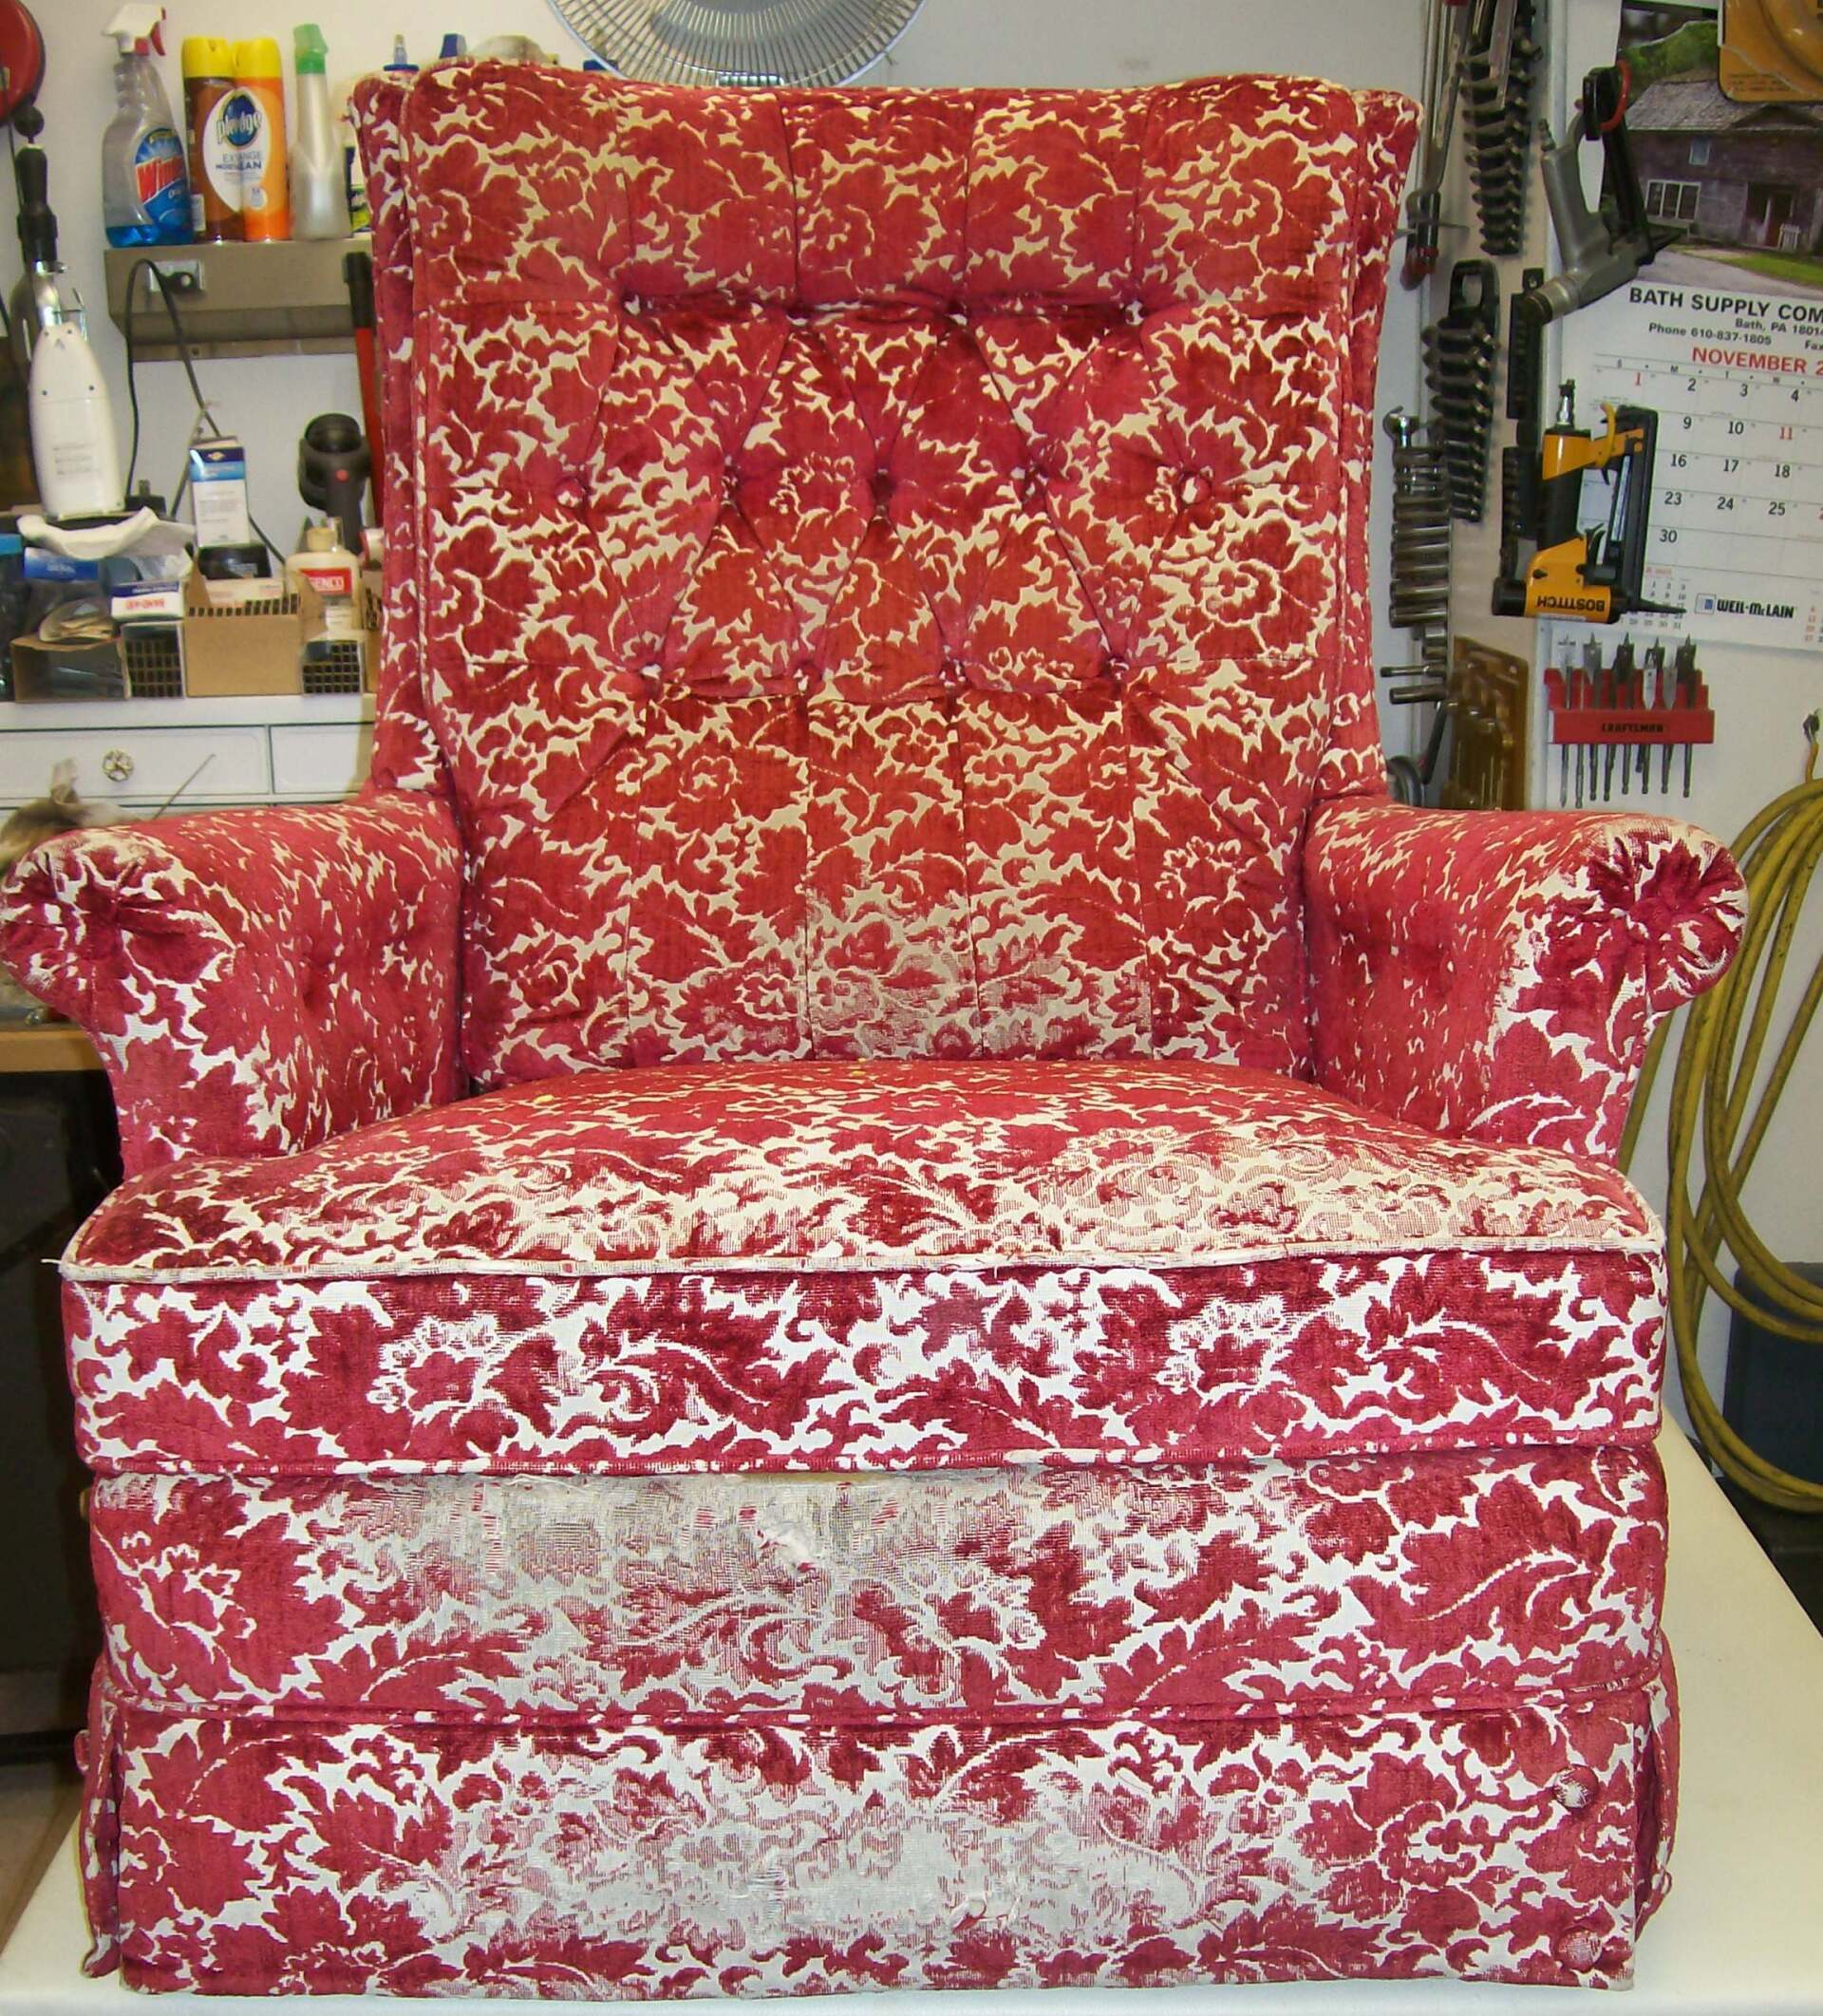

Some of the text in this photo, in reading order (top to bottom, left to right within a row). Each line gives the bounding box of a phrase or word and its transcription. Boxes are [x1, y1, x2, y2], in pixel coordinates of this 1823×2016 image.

[1629, 287, 1684, 308] BATH
[1691, 293, 1771, 317] SUPPLY
[1648, 322, 1687, 336] Phone
[1690, 327, 1772, 346] 610-837-1805
[1736, 317, 1766, 331] Bath,
[1771, 321, 1787, 333] PA
[1692, 347, 1807, 373] NOVEMBER
[1687, 377, 1697, 392] 2
[1739, 383, 1749, 397] 3
[1791, 388, 1799, 403] 4
[1682, 416, 1794, 440] 9 10 11
[1670, 453, 1791, 478] 16 17 18
[1664, 491, 1786, 516] 23 24 25
[1659, 529, 1678, 542] 30
[1536, 594, 1606, 612] BOSTITCH
